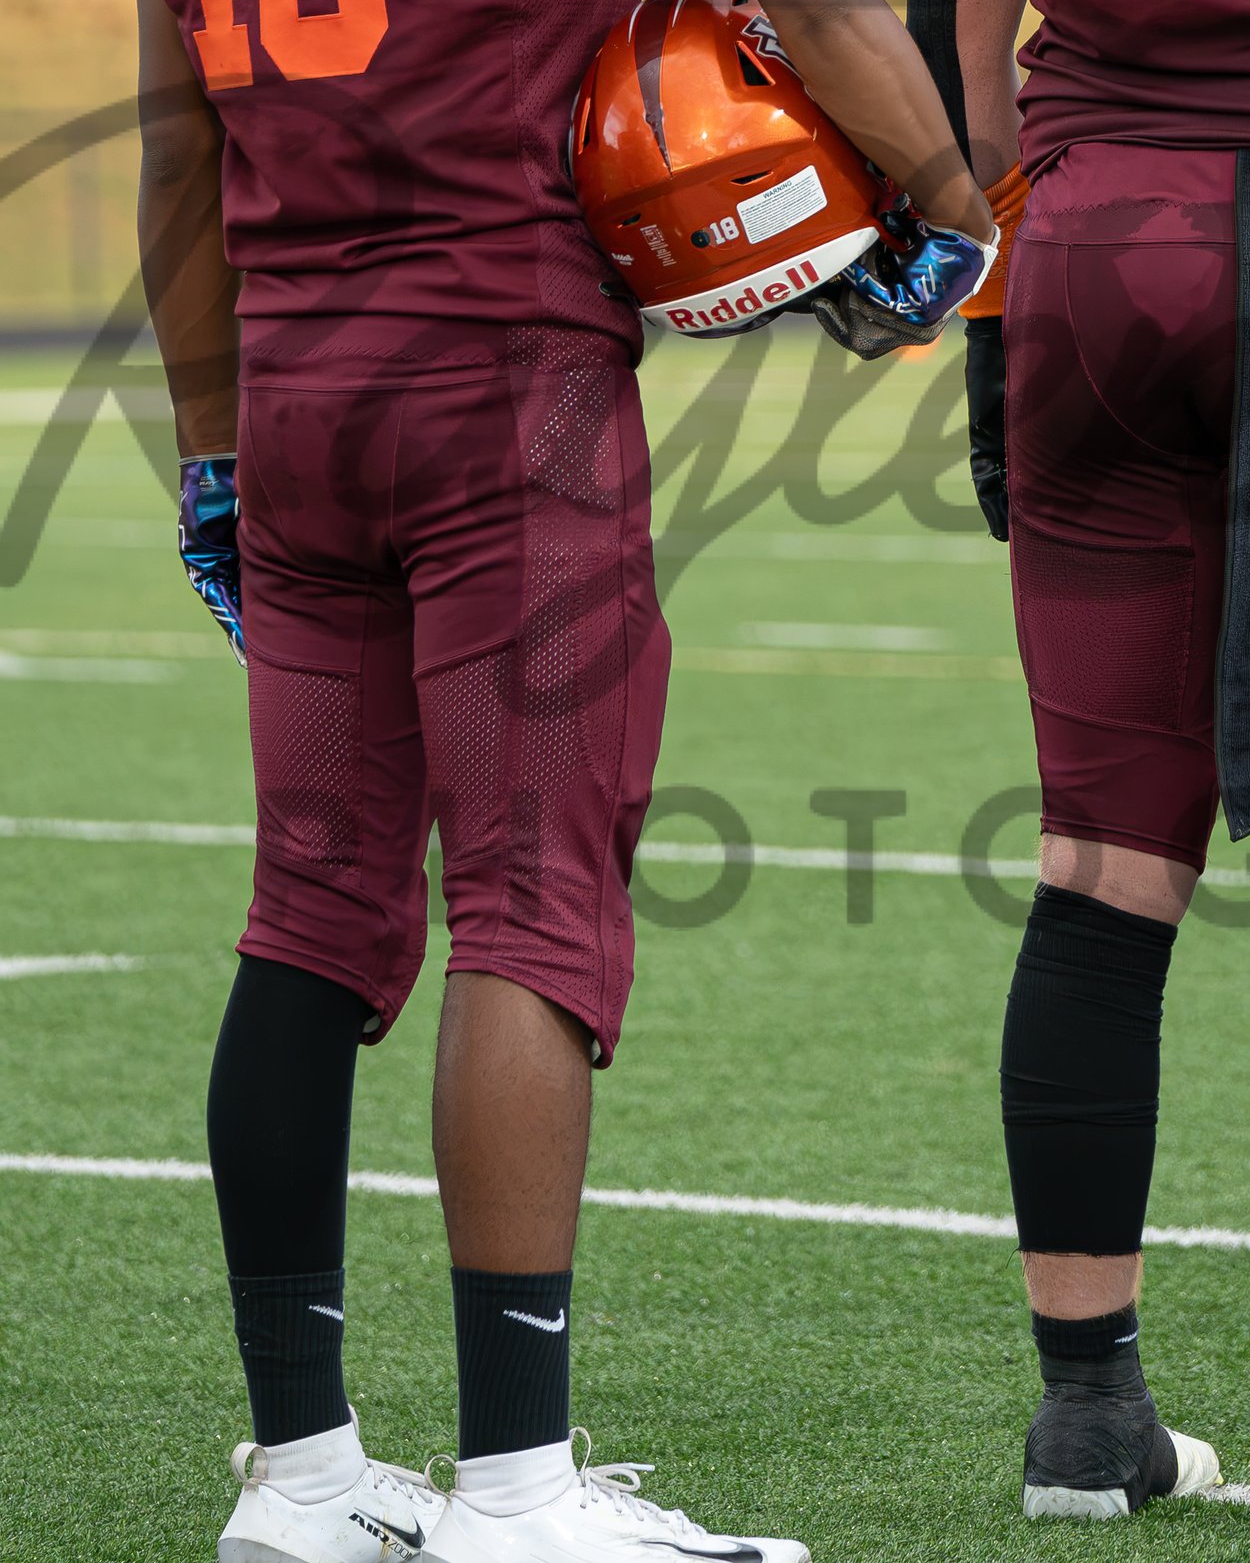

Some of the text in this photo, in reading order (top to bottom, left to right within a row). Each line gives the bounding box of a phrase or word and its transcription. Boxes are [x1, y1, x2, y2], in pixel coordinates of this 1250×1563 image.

[709, 216, 740, 245] 18
[665, 259, 820, 329] Riddell
[348, 1512, 390, 1544] AIR
